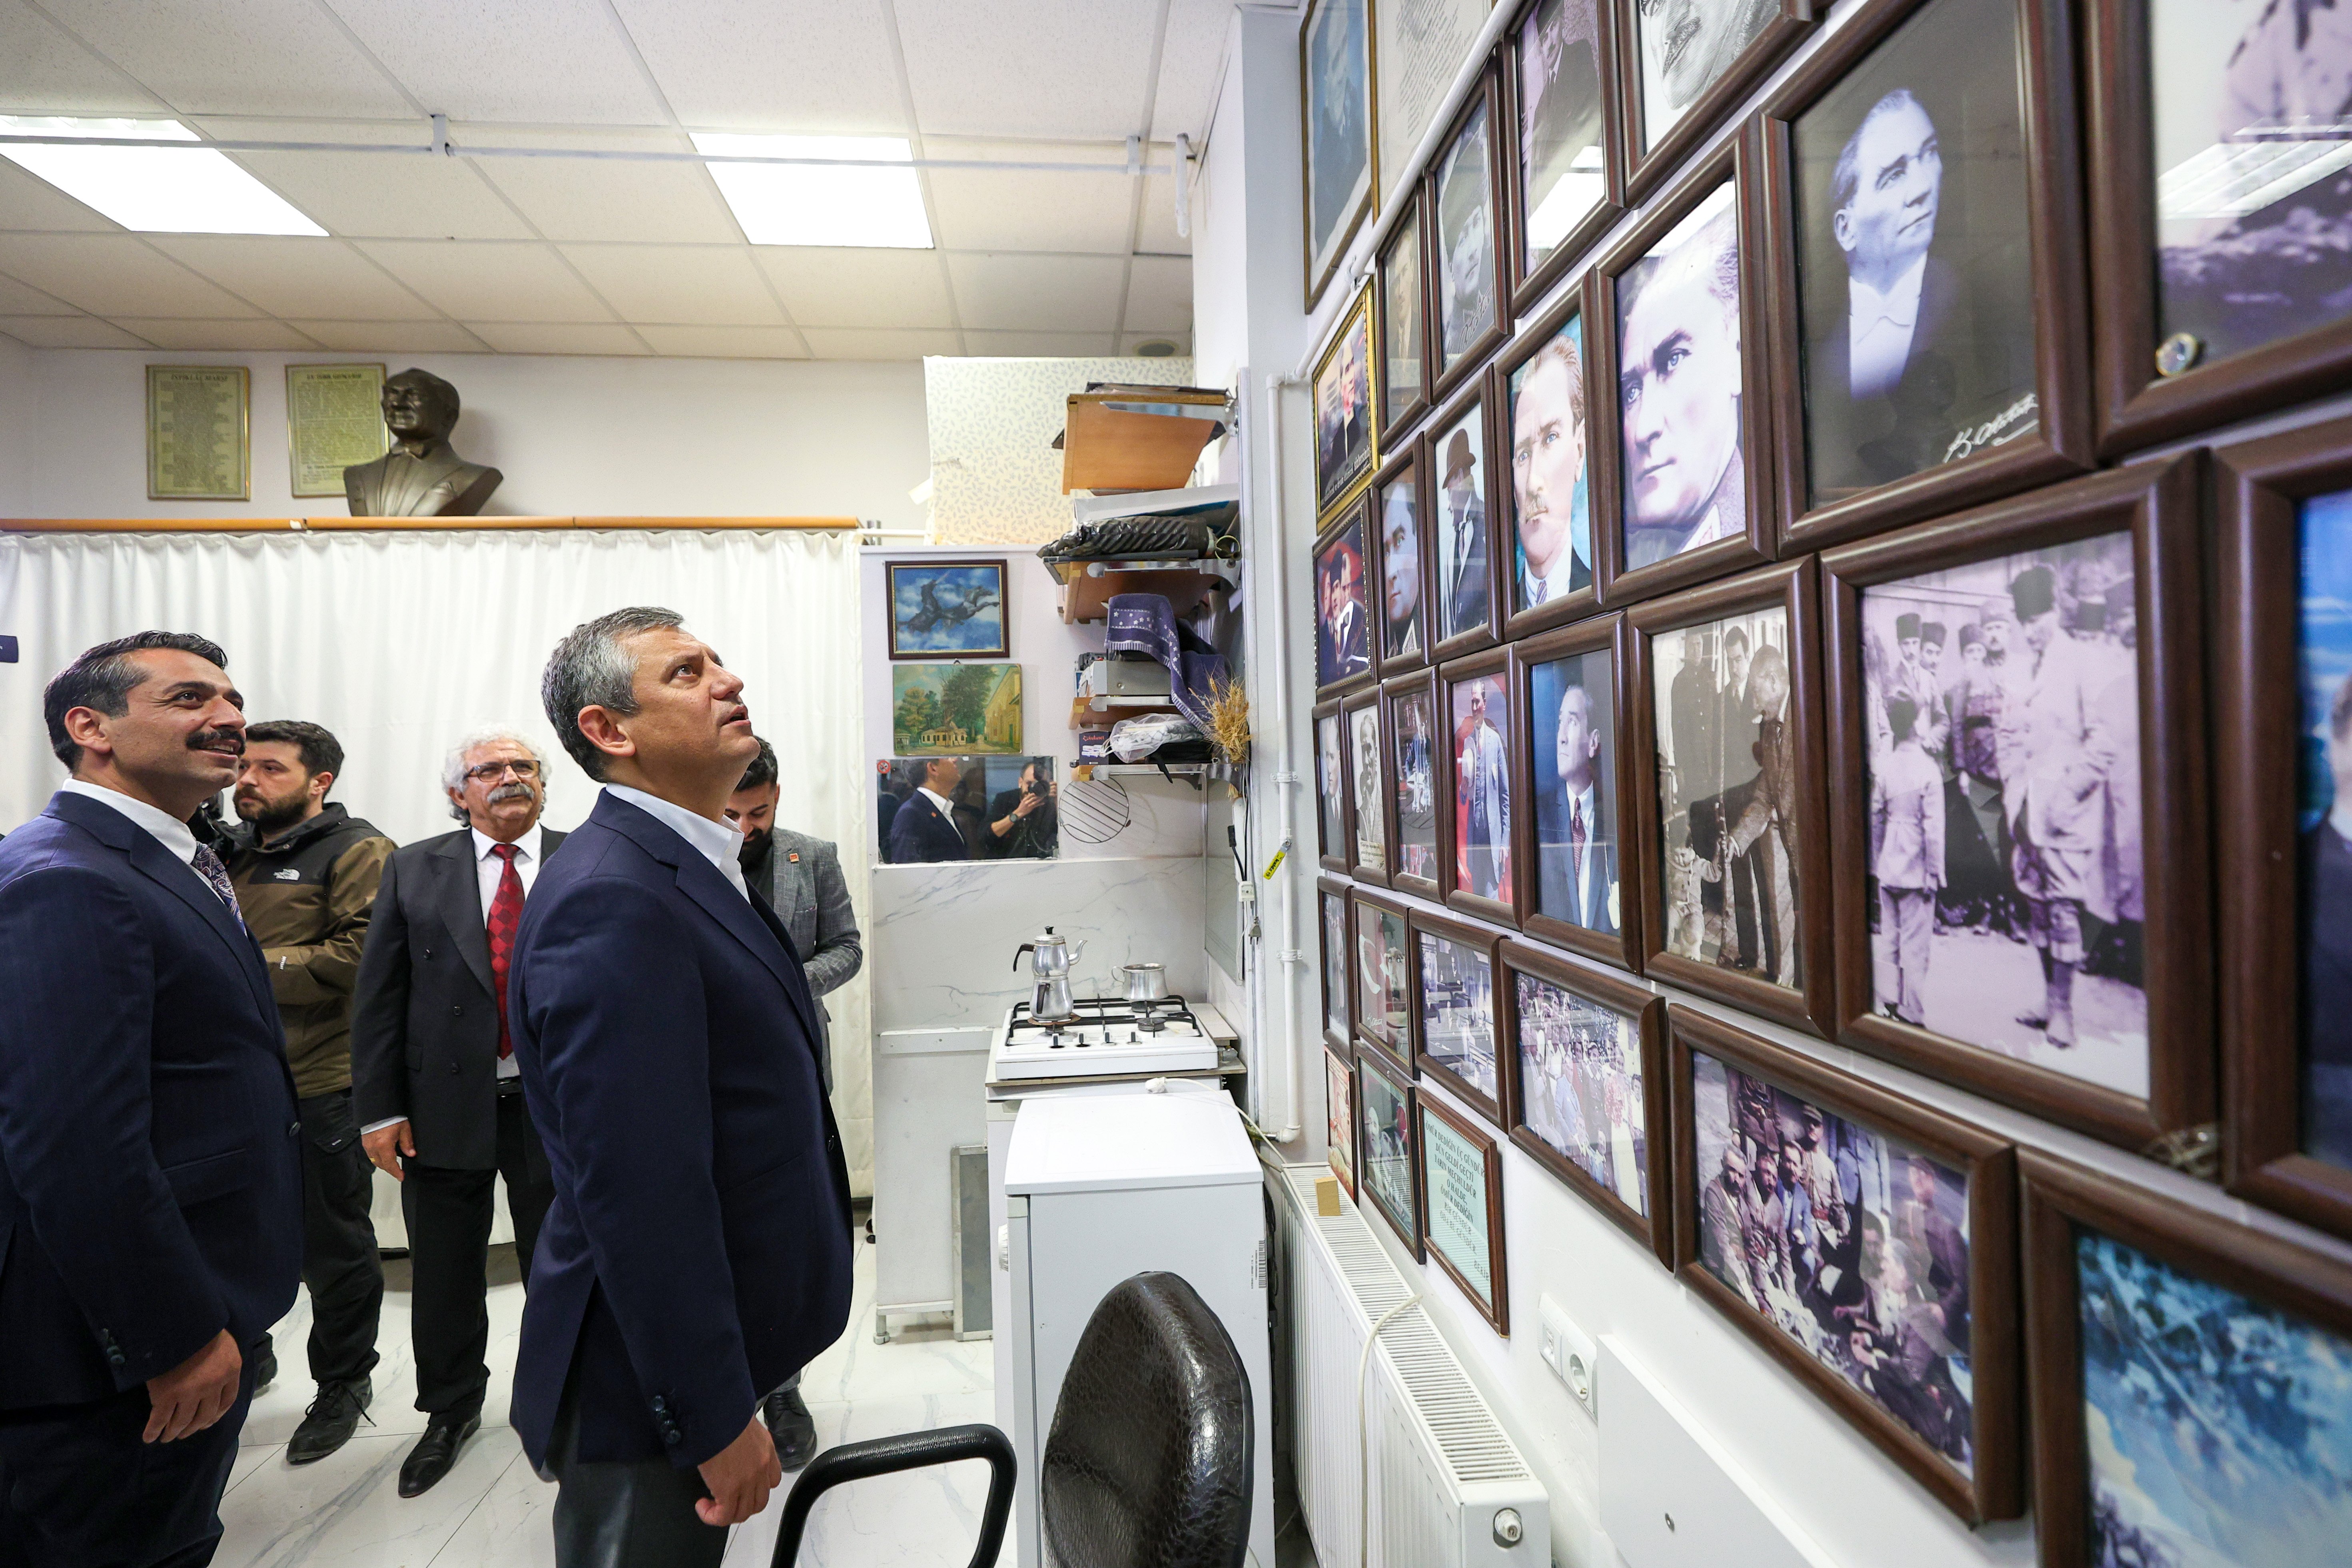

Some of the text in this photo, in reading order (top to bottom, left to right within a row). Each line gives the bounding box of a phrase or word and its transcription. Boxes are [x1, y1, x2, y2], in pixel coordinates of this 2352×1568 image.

[1426, 1120, 1485, 1177] ÖMÜR DEDİĞİN ÜÇ GÜNDÜR
[1436, 1143, 1474, 1183] DÜN GELDİ GEÇTİ
[1434, 1154, 1476, 1199] YARIN MEÇHULDÜR
[1447, 1179, 1467, 1205] O HALDE,
[1440, 1184, 1474, 1223] ÖMÜR DEDİĞİN
